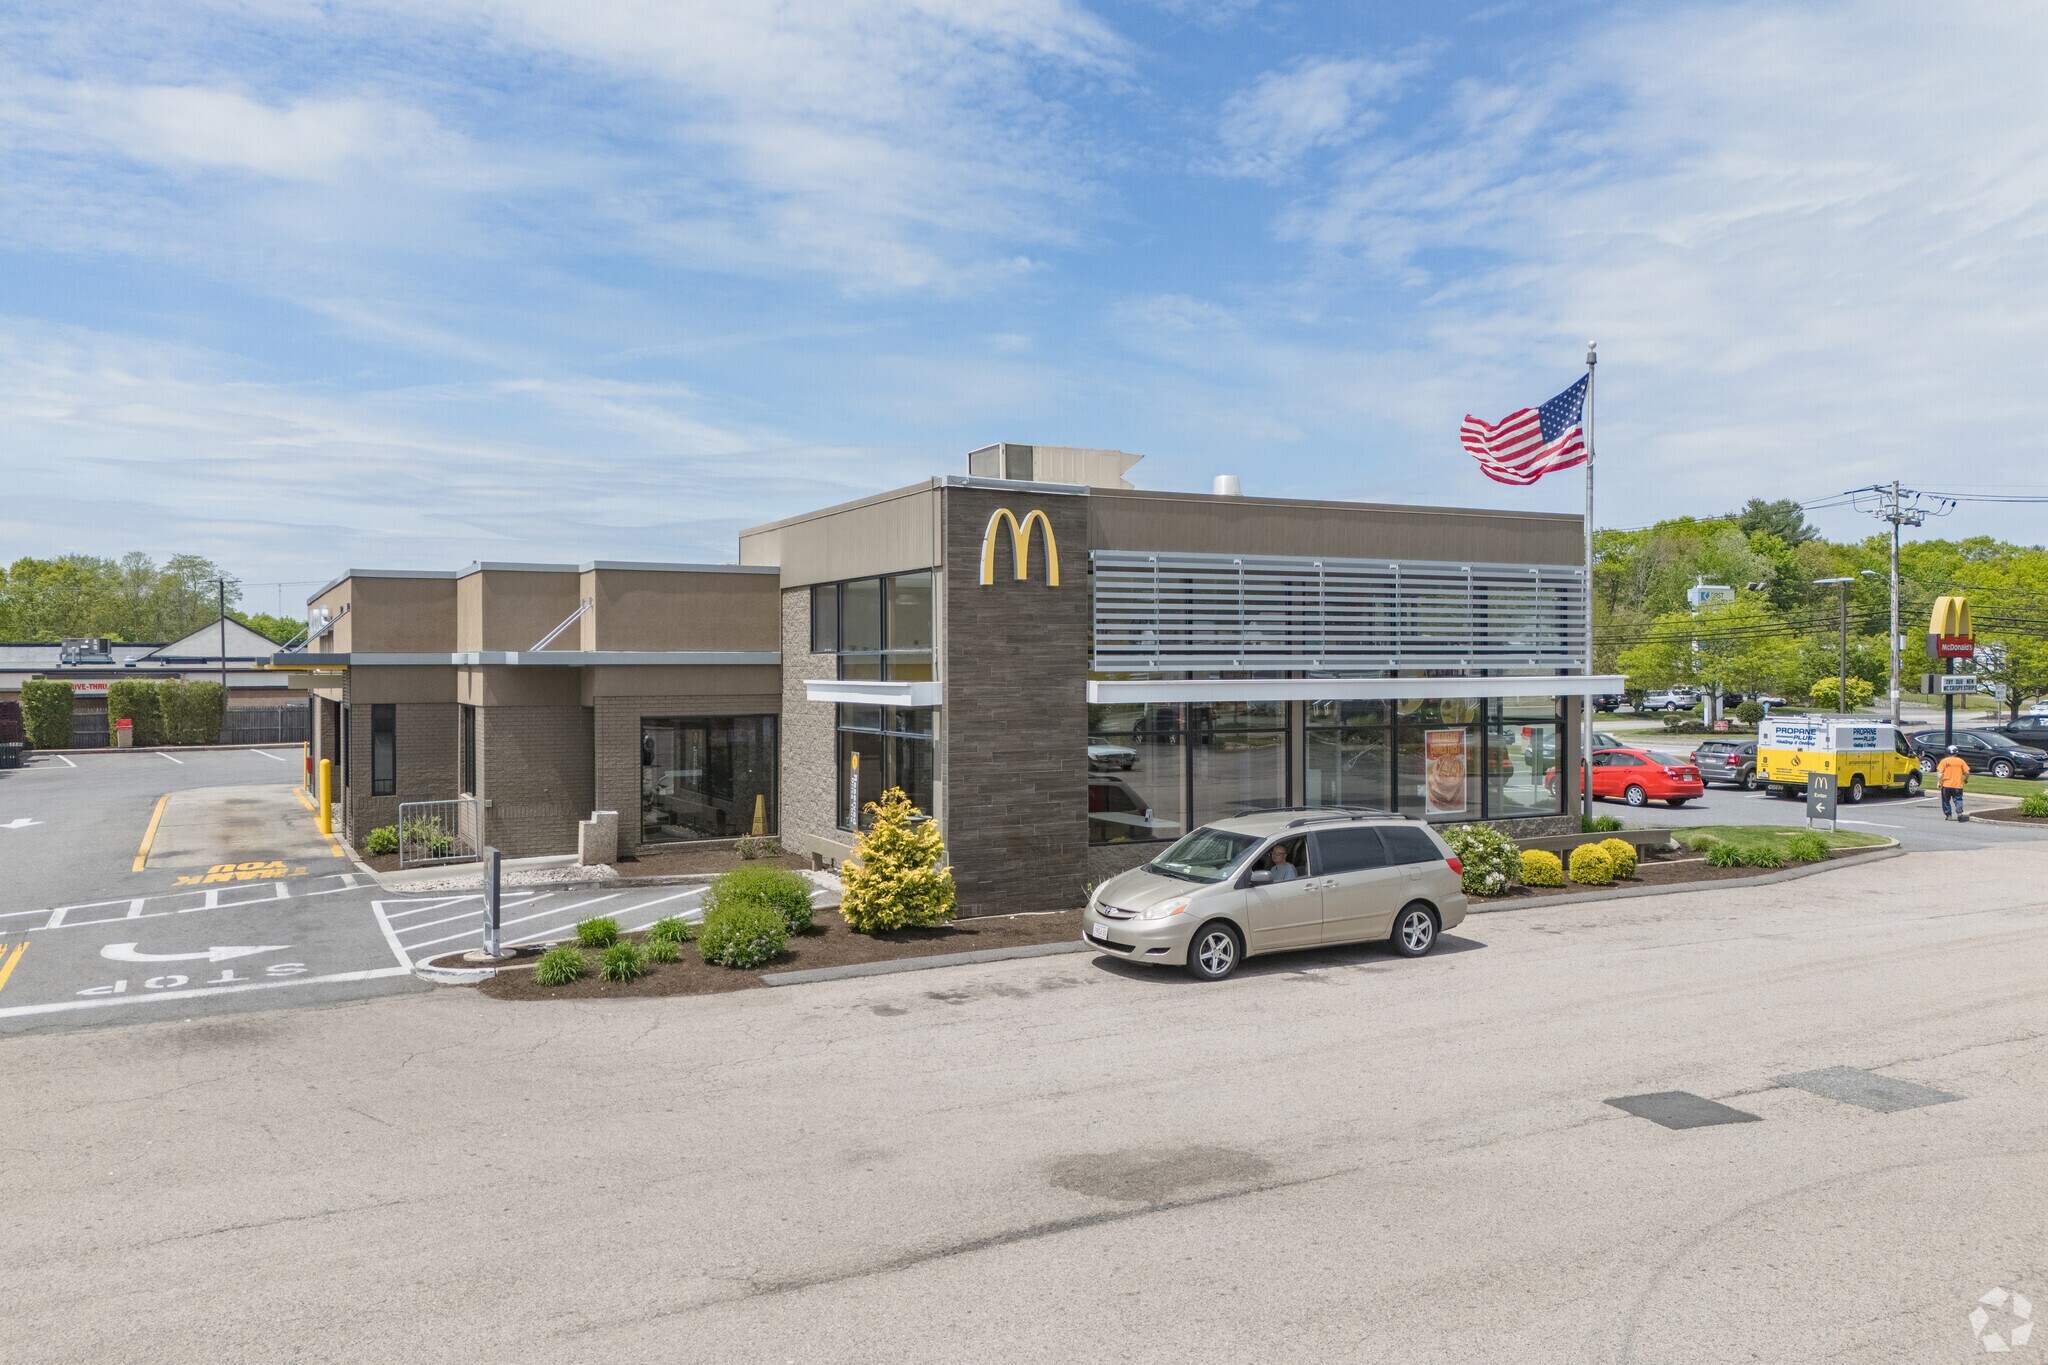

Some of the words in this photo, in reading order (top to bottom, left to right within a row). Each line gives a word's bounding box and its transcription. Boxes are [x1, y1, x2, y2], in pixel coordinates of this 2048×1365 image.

[1941, 643, 1973, 651] McDonald's
[1775, 727, 1817, 735] PROPANE
[207, 861, 288, 874] YOU
[76, 963, 308, 995] STOP
